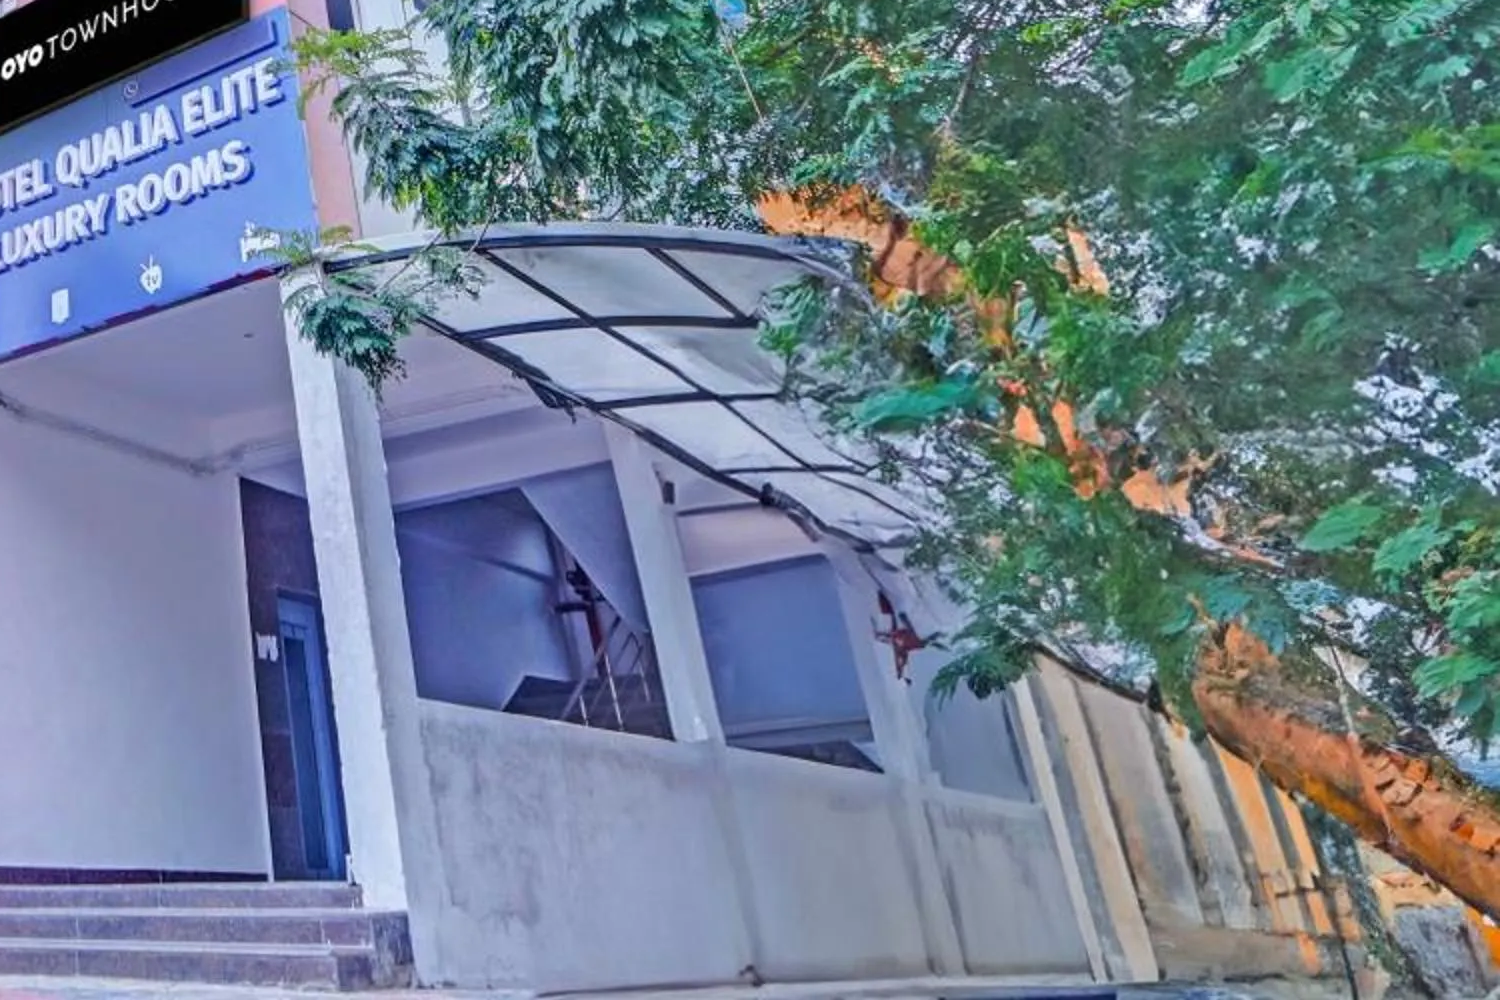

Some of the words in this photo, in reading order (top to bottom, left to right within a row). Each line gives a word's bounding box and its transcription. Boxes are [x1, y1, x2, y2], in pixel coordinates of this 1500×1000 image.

[0, 43, 43, 81] OYO
[55, 105, 180, 188] QUALIA
[182, 57, 283, 133] ELITE
[116, 140, 252, 223] ROOMS
